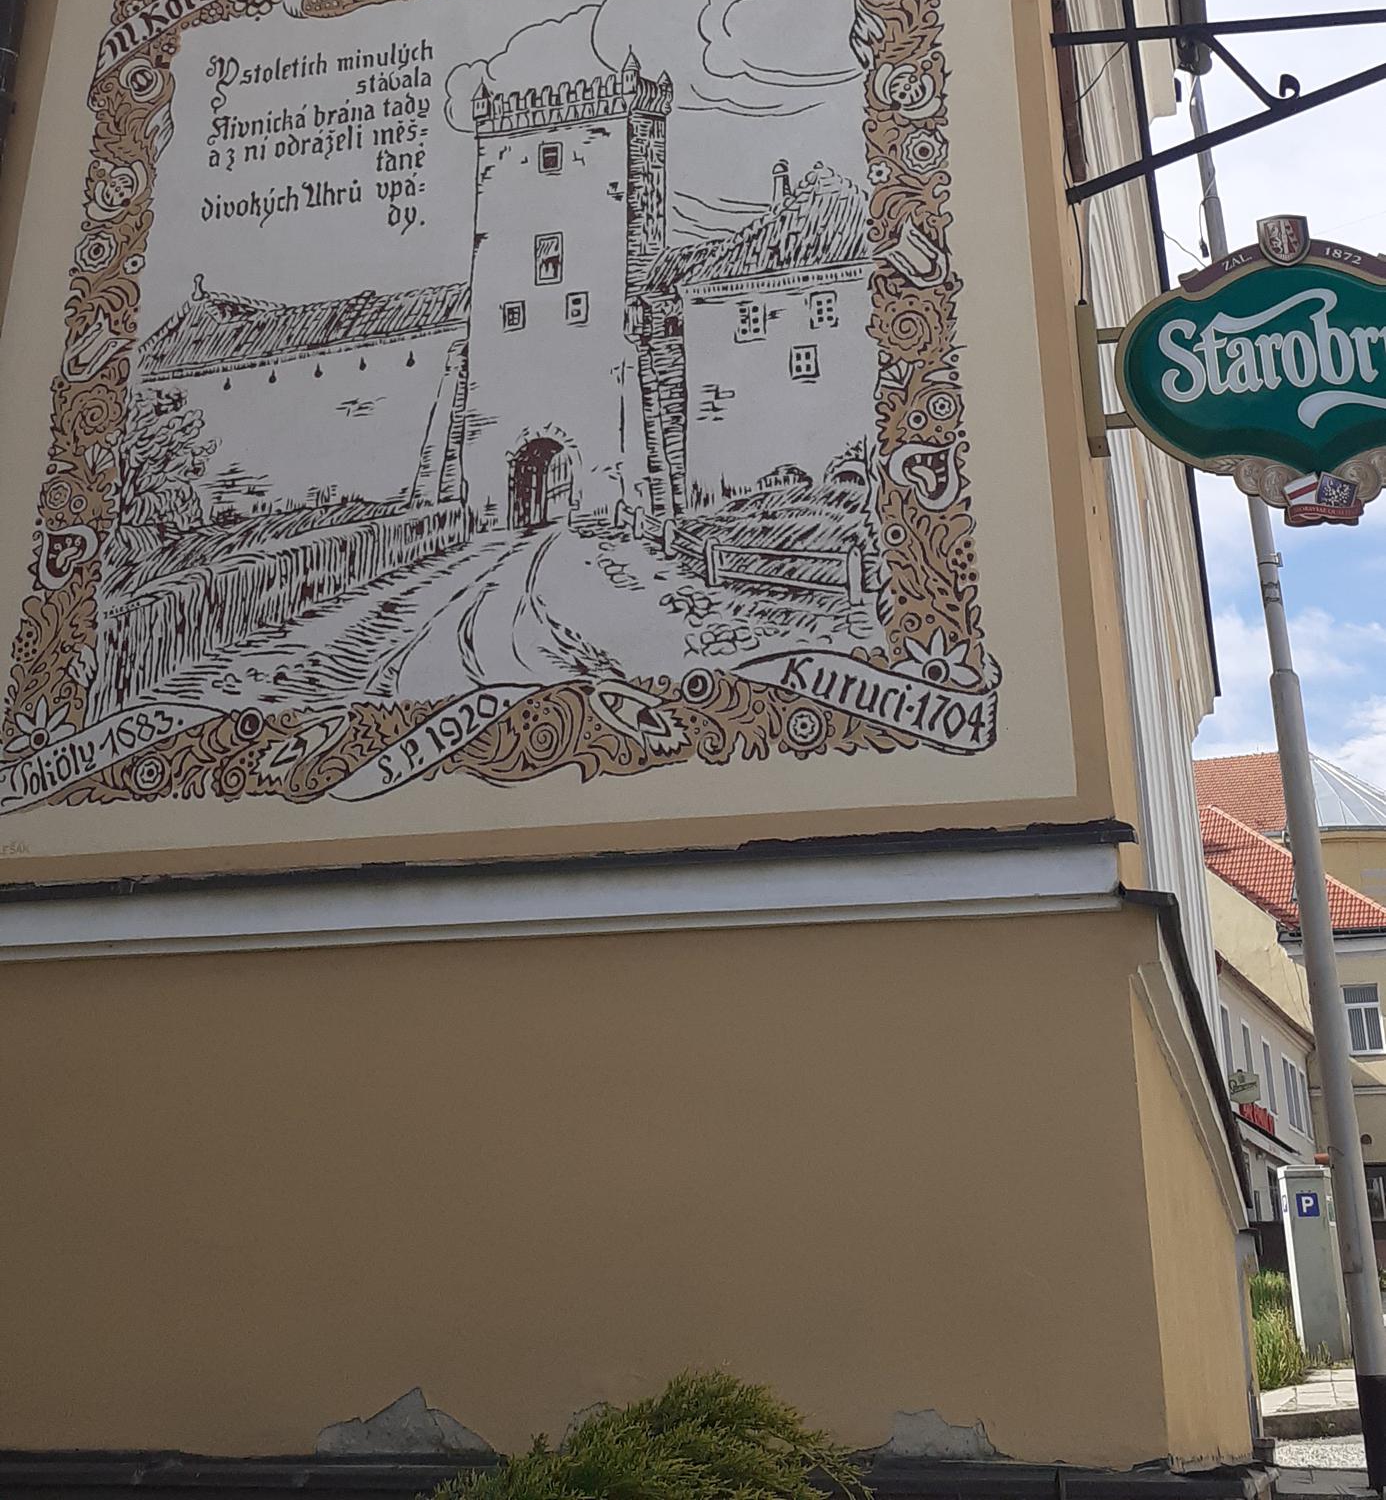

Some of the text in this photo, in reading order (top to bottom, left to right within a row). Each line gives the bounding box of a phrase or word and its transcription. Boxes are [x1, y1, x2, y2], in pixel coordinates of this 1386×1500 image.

[336, 39, 433, 70] minulých
[313, 99, 375, 127] brána
[383, 92, 430, 118] tady
[202, 186, 299, 228] divokých
[1222, 247, 1361, 271] ZAL. 1872
[1301, 1196, 1314, 1213] P
